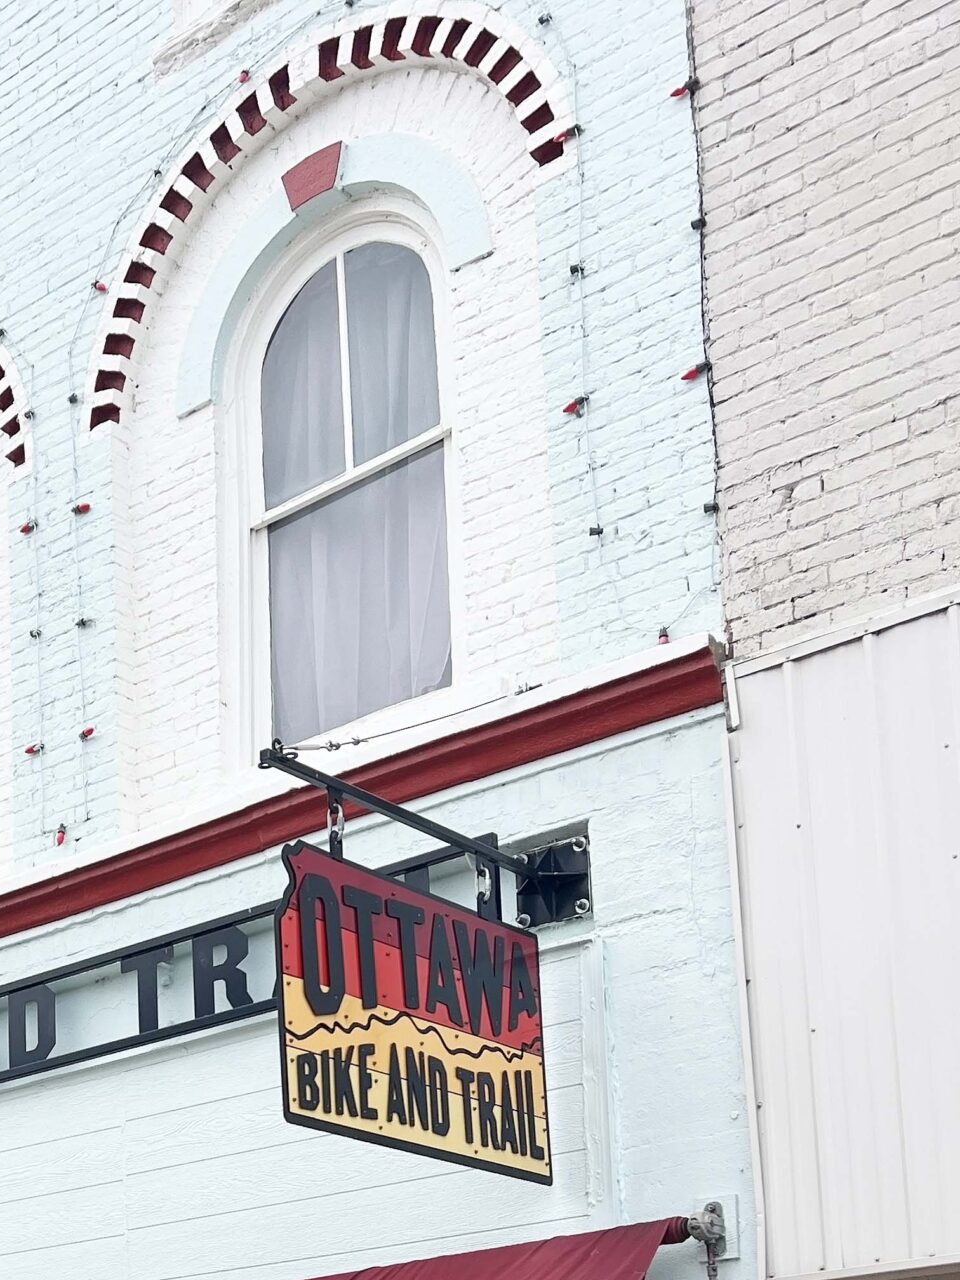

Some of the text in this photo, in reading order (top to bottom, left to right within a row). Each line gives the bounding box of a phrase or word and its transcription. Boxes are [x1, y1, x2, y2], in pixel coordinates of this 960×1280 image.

[120, 925, 278, 1032] TR
[298, 873, 538, 1037] OTTAWA
[297, 1042, 545, 1161] BIKE AND TRAIL
